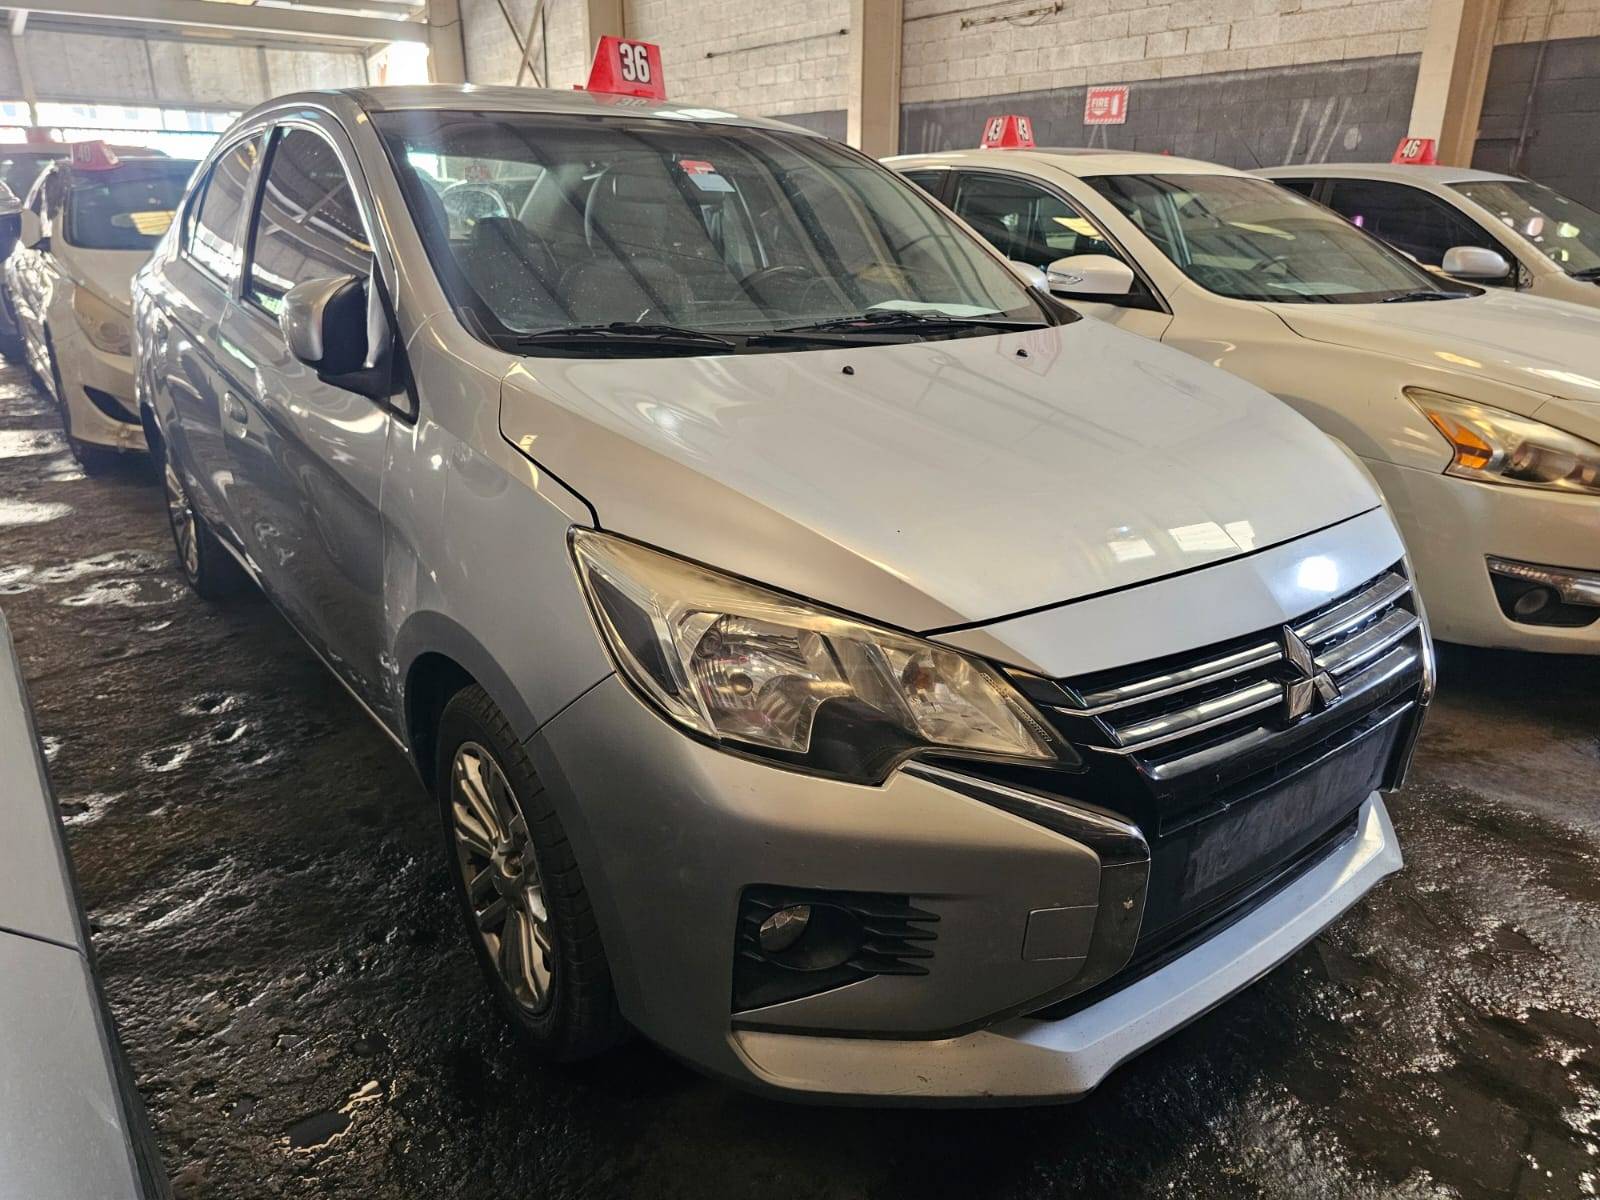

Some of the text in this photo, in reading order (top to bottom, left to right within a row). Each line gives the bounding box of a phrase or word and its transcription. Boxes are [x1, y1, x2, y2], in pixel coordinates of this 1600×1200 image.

[619, 42, 651, 83] 36
[1091, 97, 1109, 108] FIRE
[988, 118, 1003, 141] 43
[1402, 139, 1421, 158] 46
